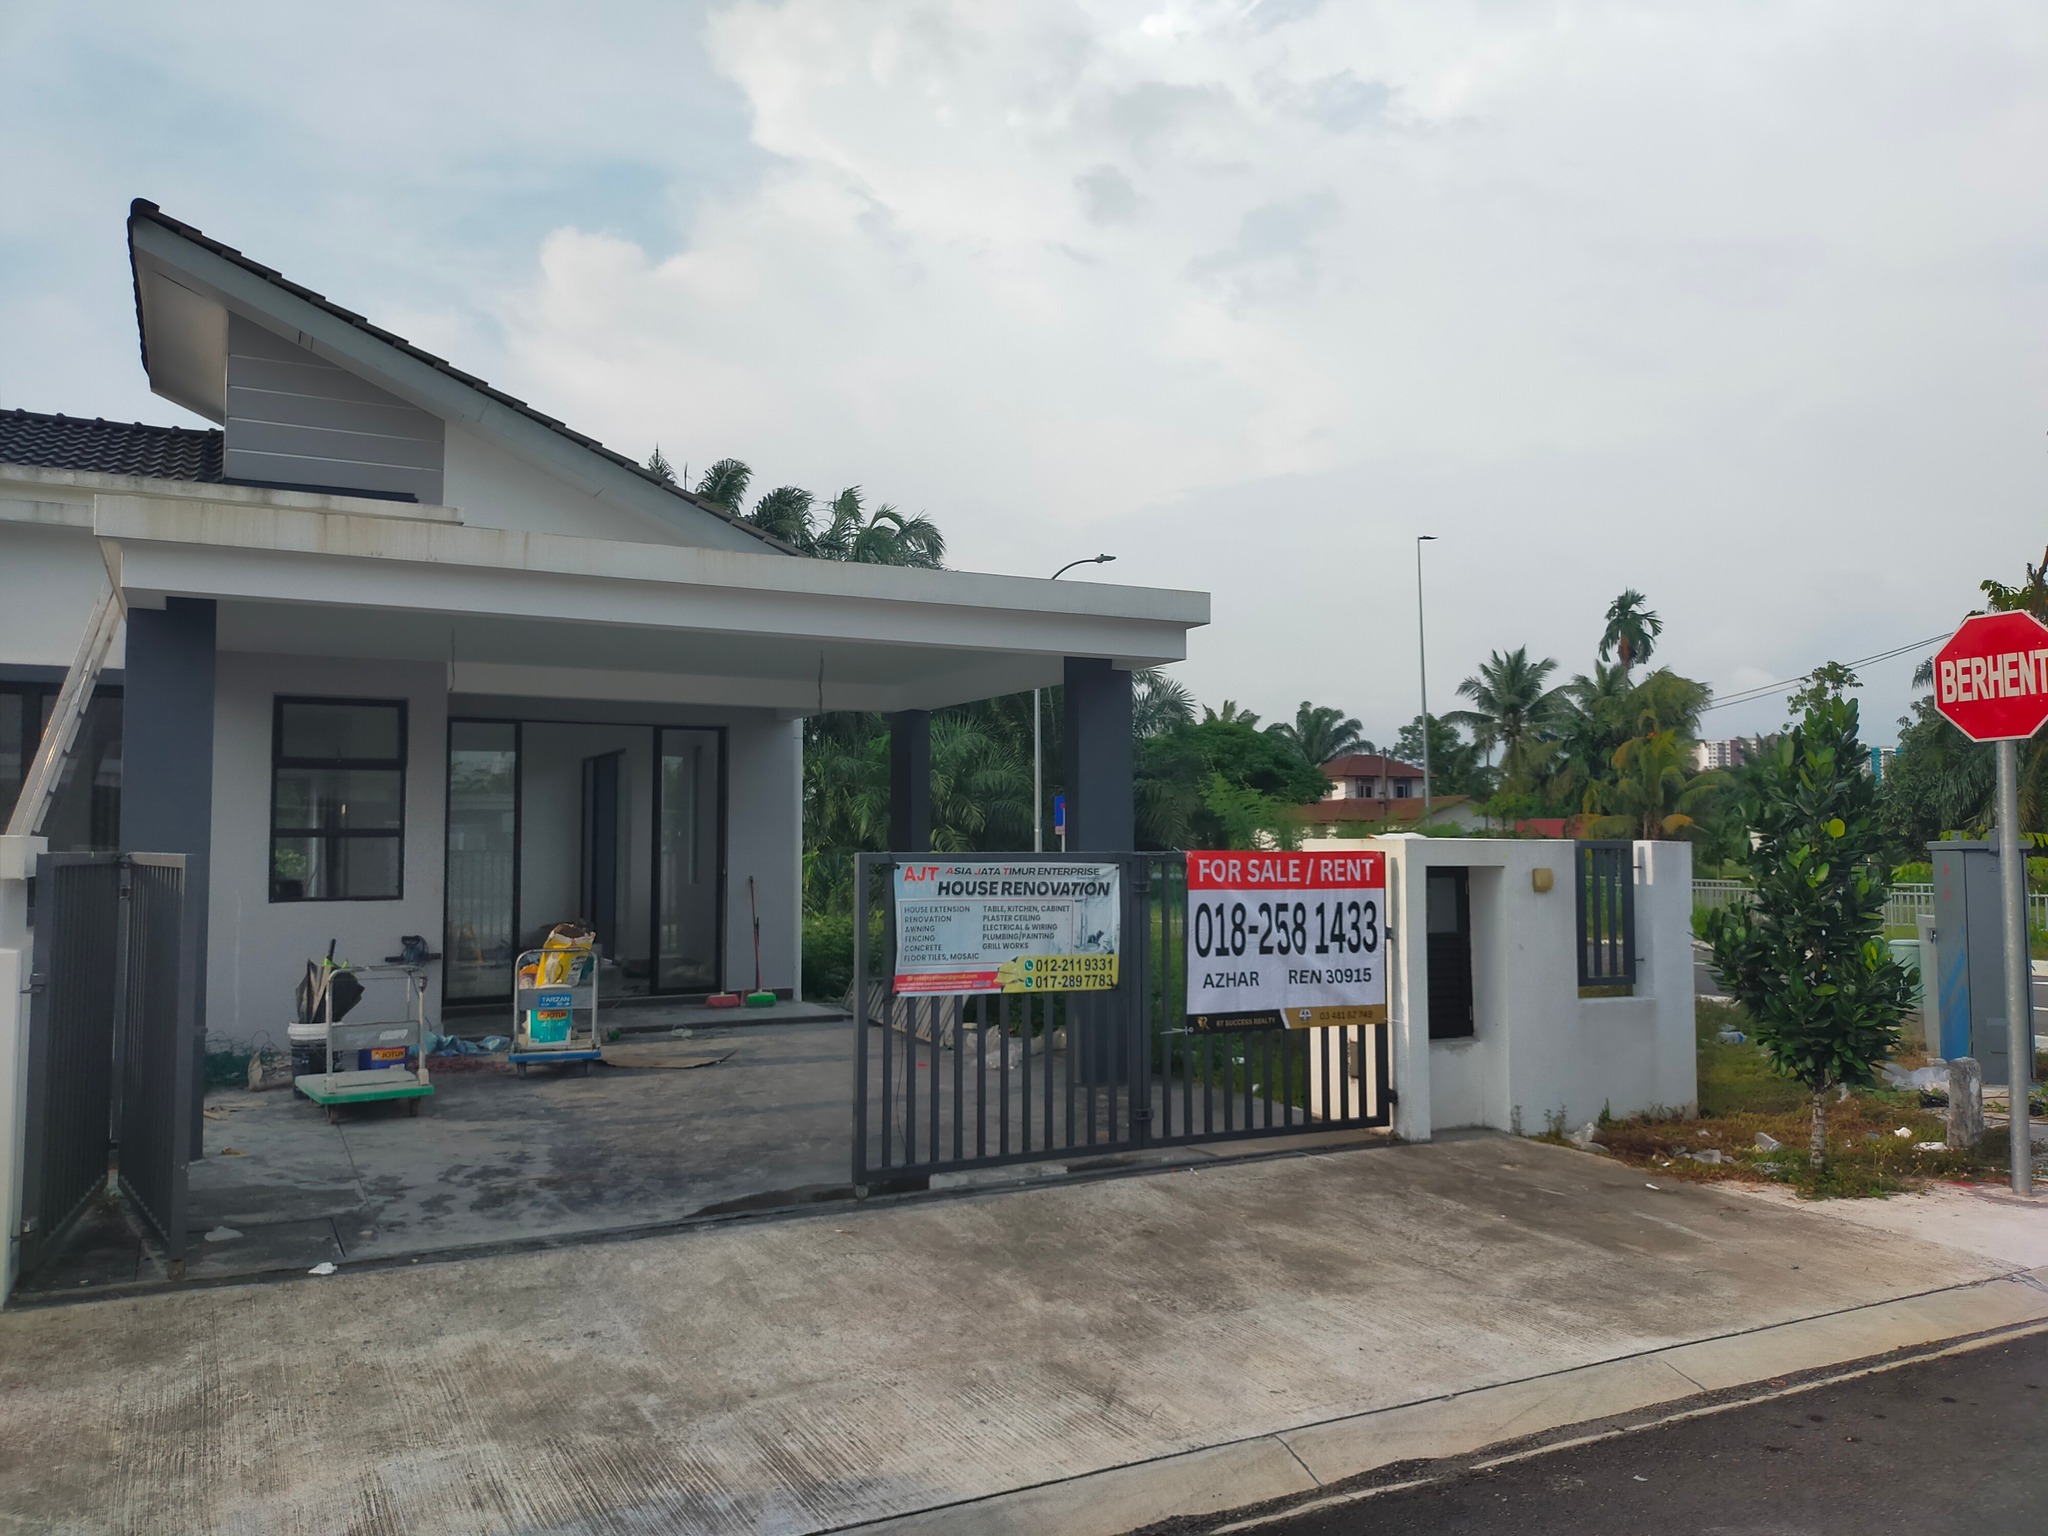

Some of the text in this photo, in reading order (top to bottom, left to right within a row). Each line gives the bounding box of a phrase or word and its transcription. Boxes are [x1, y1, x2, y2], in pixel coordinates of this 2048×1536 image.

[904, 867, 939, 881] AJT
[946, 867, 1100, 876] ASIA JATA TIMUR ENTERPRISE
[1199, 859, 1374, 885] FOR SALE / RENT
[938, 881, 1110, 896] HOUSE RENOVATION
[983, 905, 1006, 913] TABLE,
[905, 925, 935, 933] AWNING
[1195, 901, 1378, 957] 018-258 1433
[983, 933, 1054, 941] PLUMBING/PAINTING
[905, 944, 942, 952] CONCRETE
[904, 954, 927, 962] FLOOR
[928, 954, 949, 962] TILES,
[1036, 959, 1113, 972] 012-211 9331
[1036, 975, 1113, 988] 017-289 7783
[1203, 968, 1371, 989] AZHAR REN 30915
[1320, 1012, 1330, 1020] 03
[1254, 1017, 1275, 1026] REALTY
